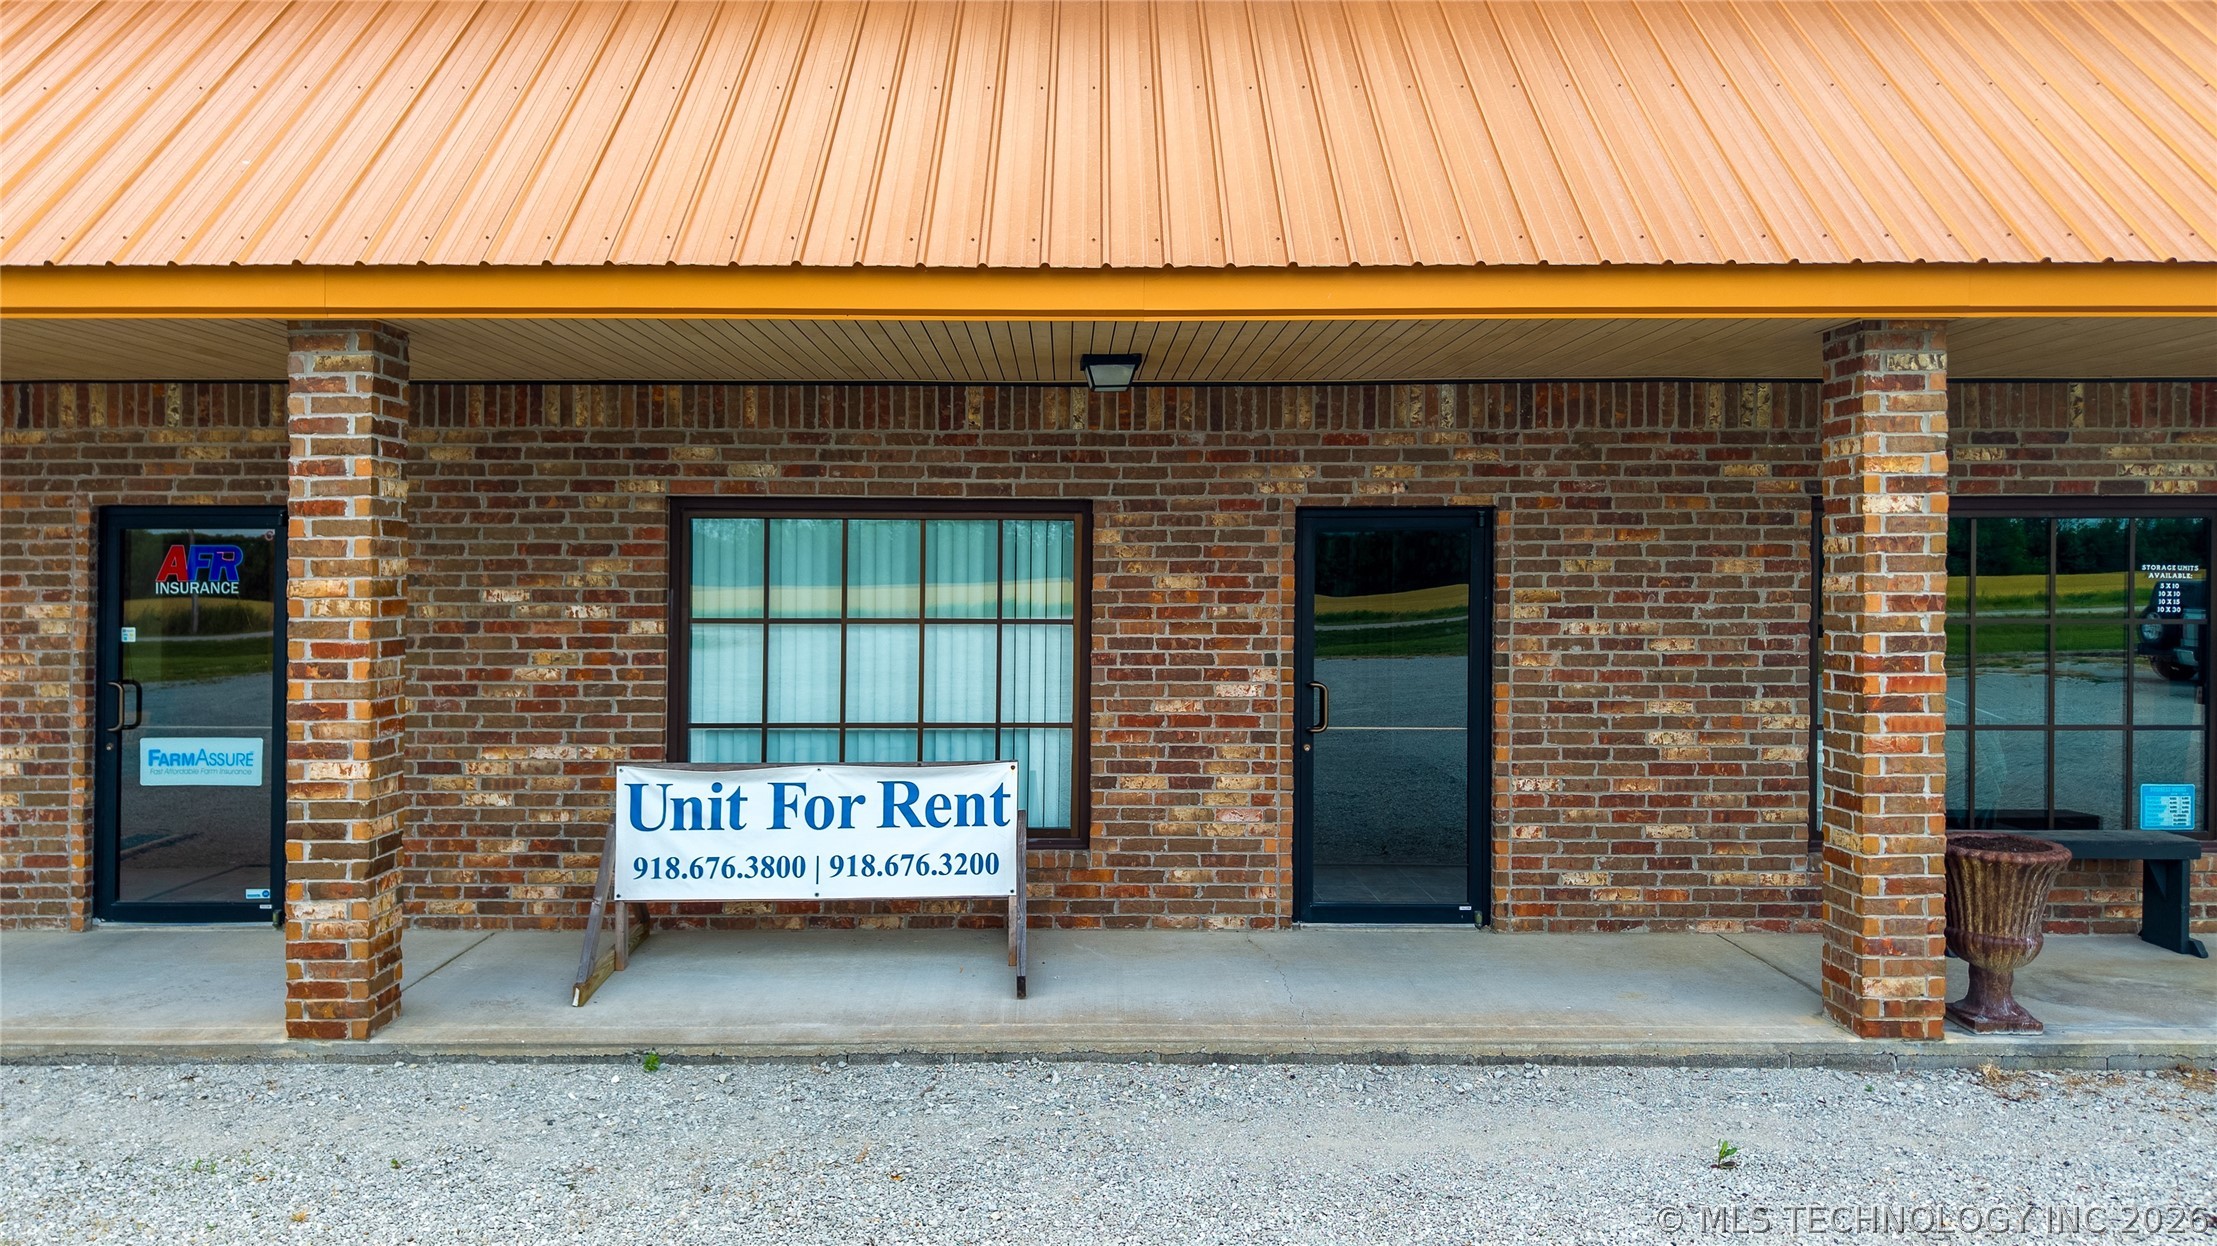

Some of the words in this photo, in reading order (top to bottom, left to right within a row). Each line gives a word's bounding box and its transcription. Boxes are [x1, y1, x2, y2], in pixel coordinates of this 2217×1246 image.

[155, 544, 244, 582] AFR
[155, 581, 240, 595] INSURANCE
[625, 782, 748, 832] Unit
[766, 781, 866, 831] For
[876, 780, 1011, 829] Rent
[633, 855, 806, 880] 918.676.3800
[829, 852, 1000, 878] 918.676.3200
